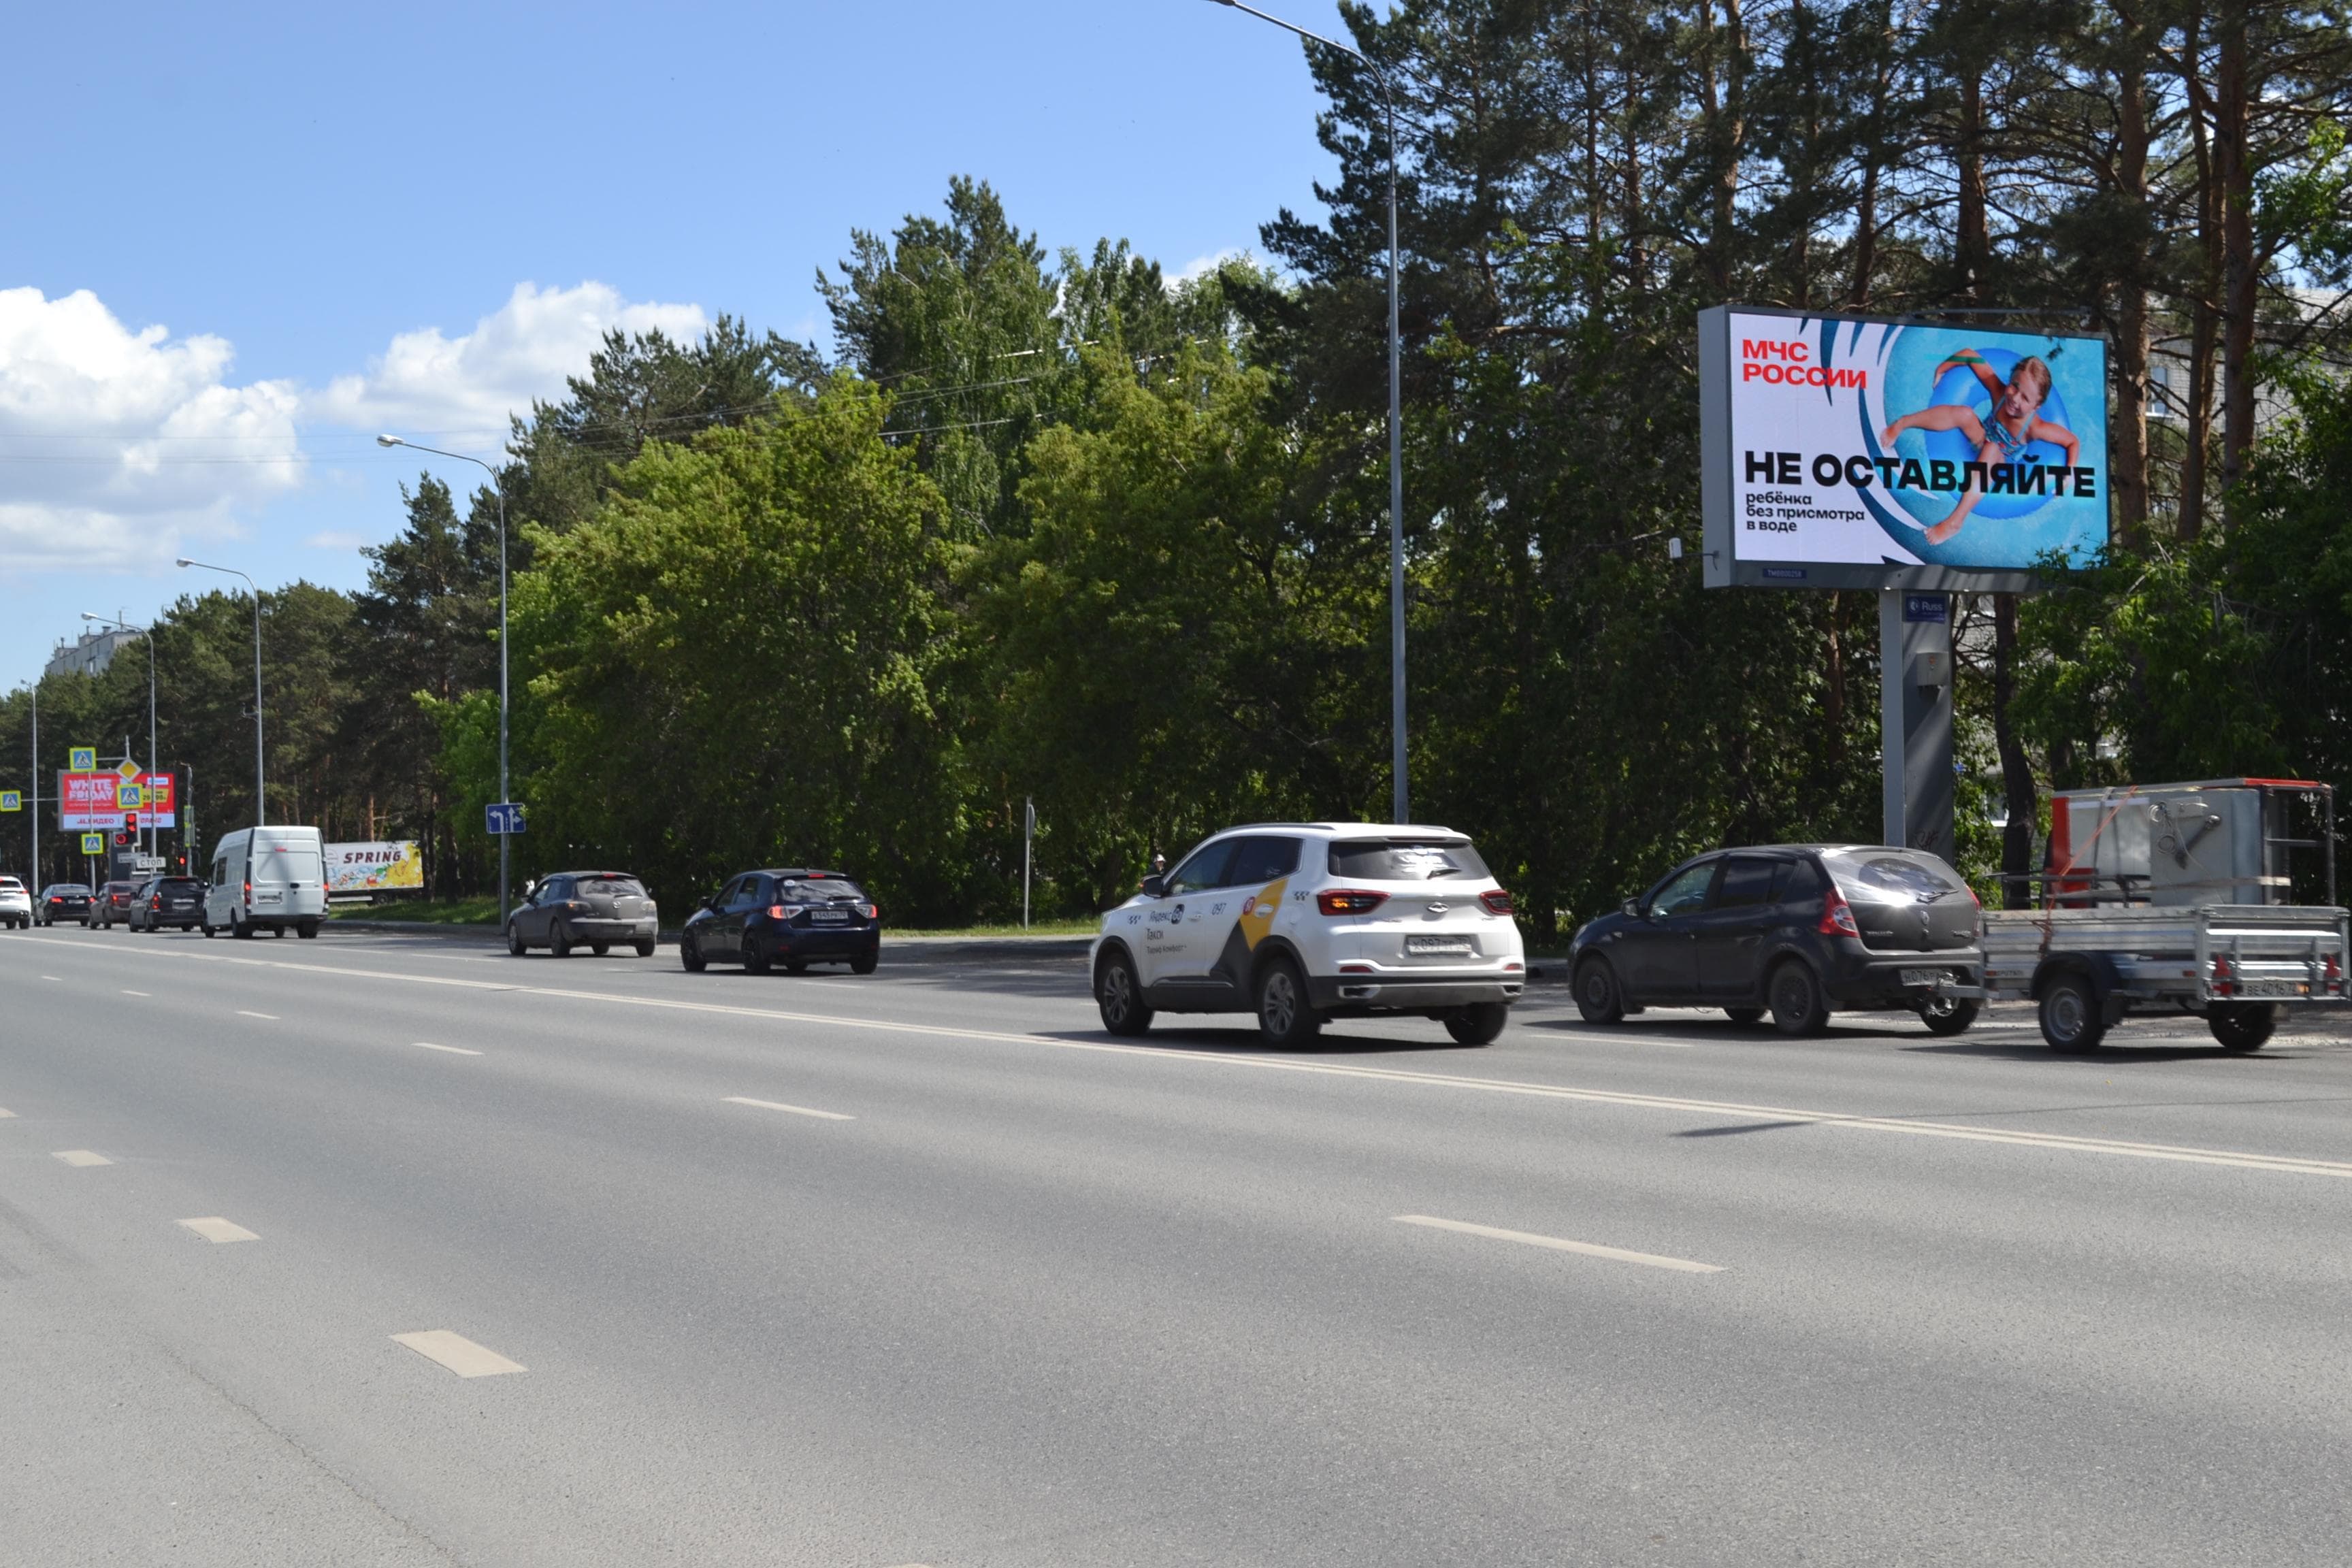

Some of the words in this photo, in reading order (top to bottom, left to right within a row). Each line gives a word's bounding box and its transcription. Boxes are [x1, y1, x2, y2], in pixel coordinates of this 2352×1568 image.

[1743, 339, 1808, 362] МЧС
[1743, 363, 1866, 389] РОССИИ
[1746, 451, 1801, 485] НЕ
[1812, 454, 2095, 498] ОСТАВЛЯЙТЕ
[1746, 491, 1812, 506] ребёнка
[1746, 505, 1774, 517] без
[1777, 508, 1865, 522] присмотра
[1747, 521, 1755, 530] в
[1759, 521, 1797, 533] воде
[1922, 602, 1943, 611] Russ
[69, 779, 112, 790] WHITE
[69, 790, 114, 801] FRIDAY
[343, 851, 402, 864] SPRING
[1212, 902, 1226, 915] 097
[1149, 910, 1171, 924] Яндекс
[1146, 928, 1164, 940] Такси
